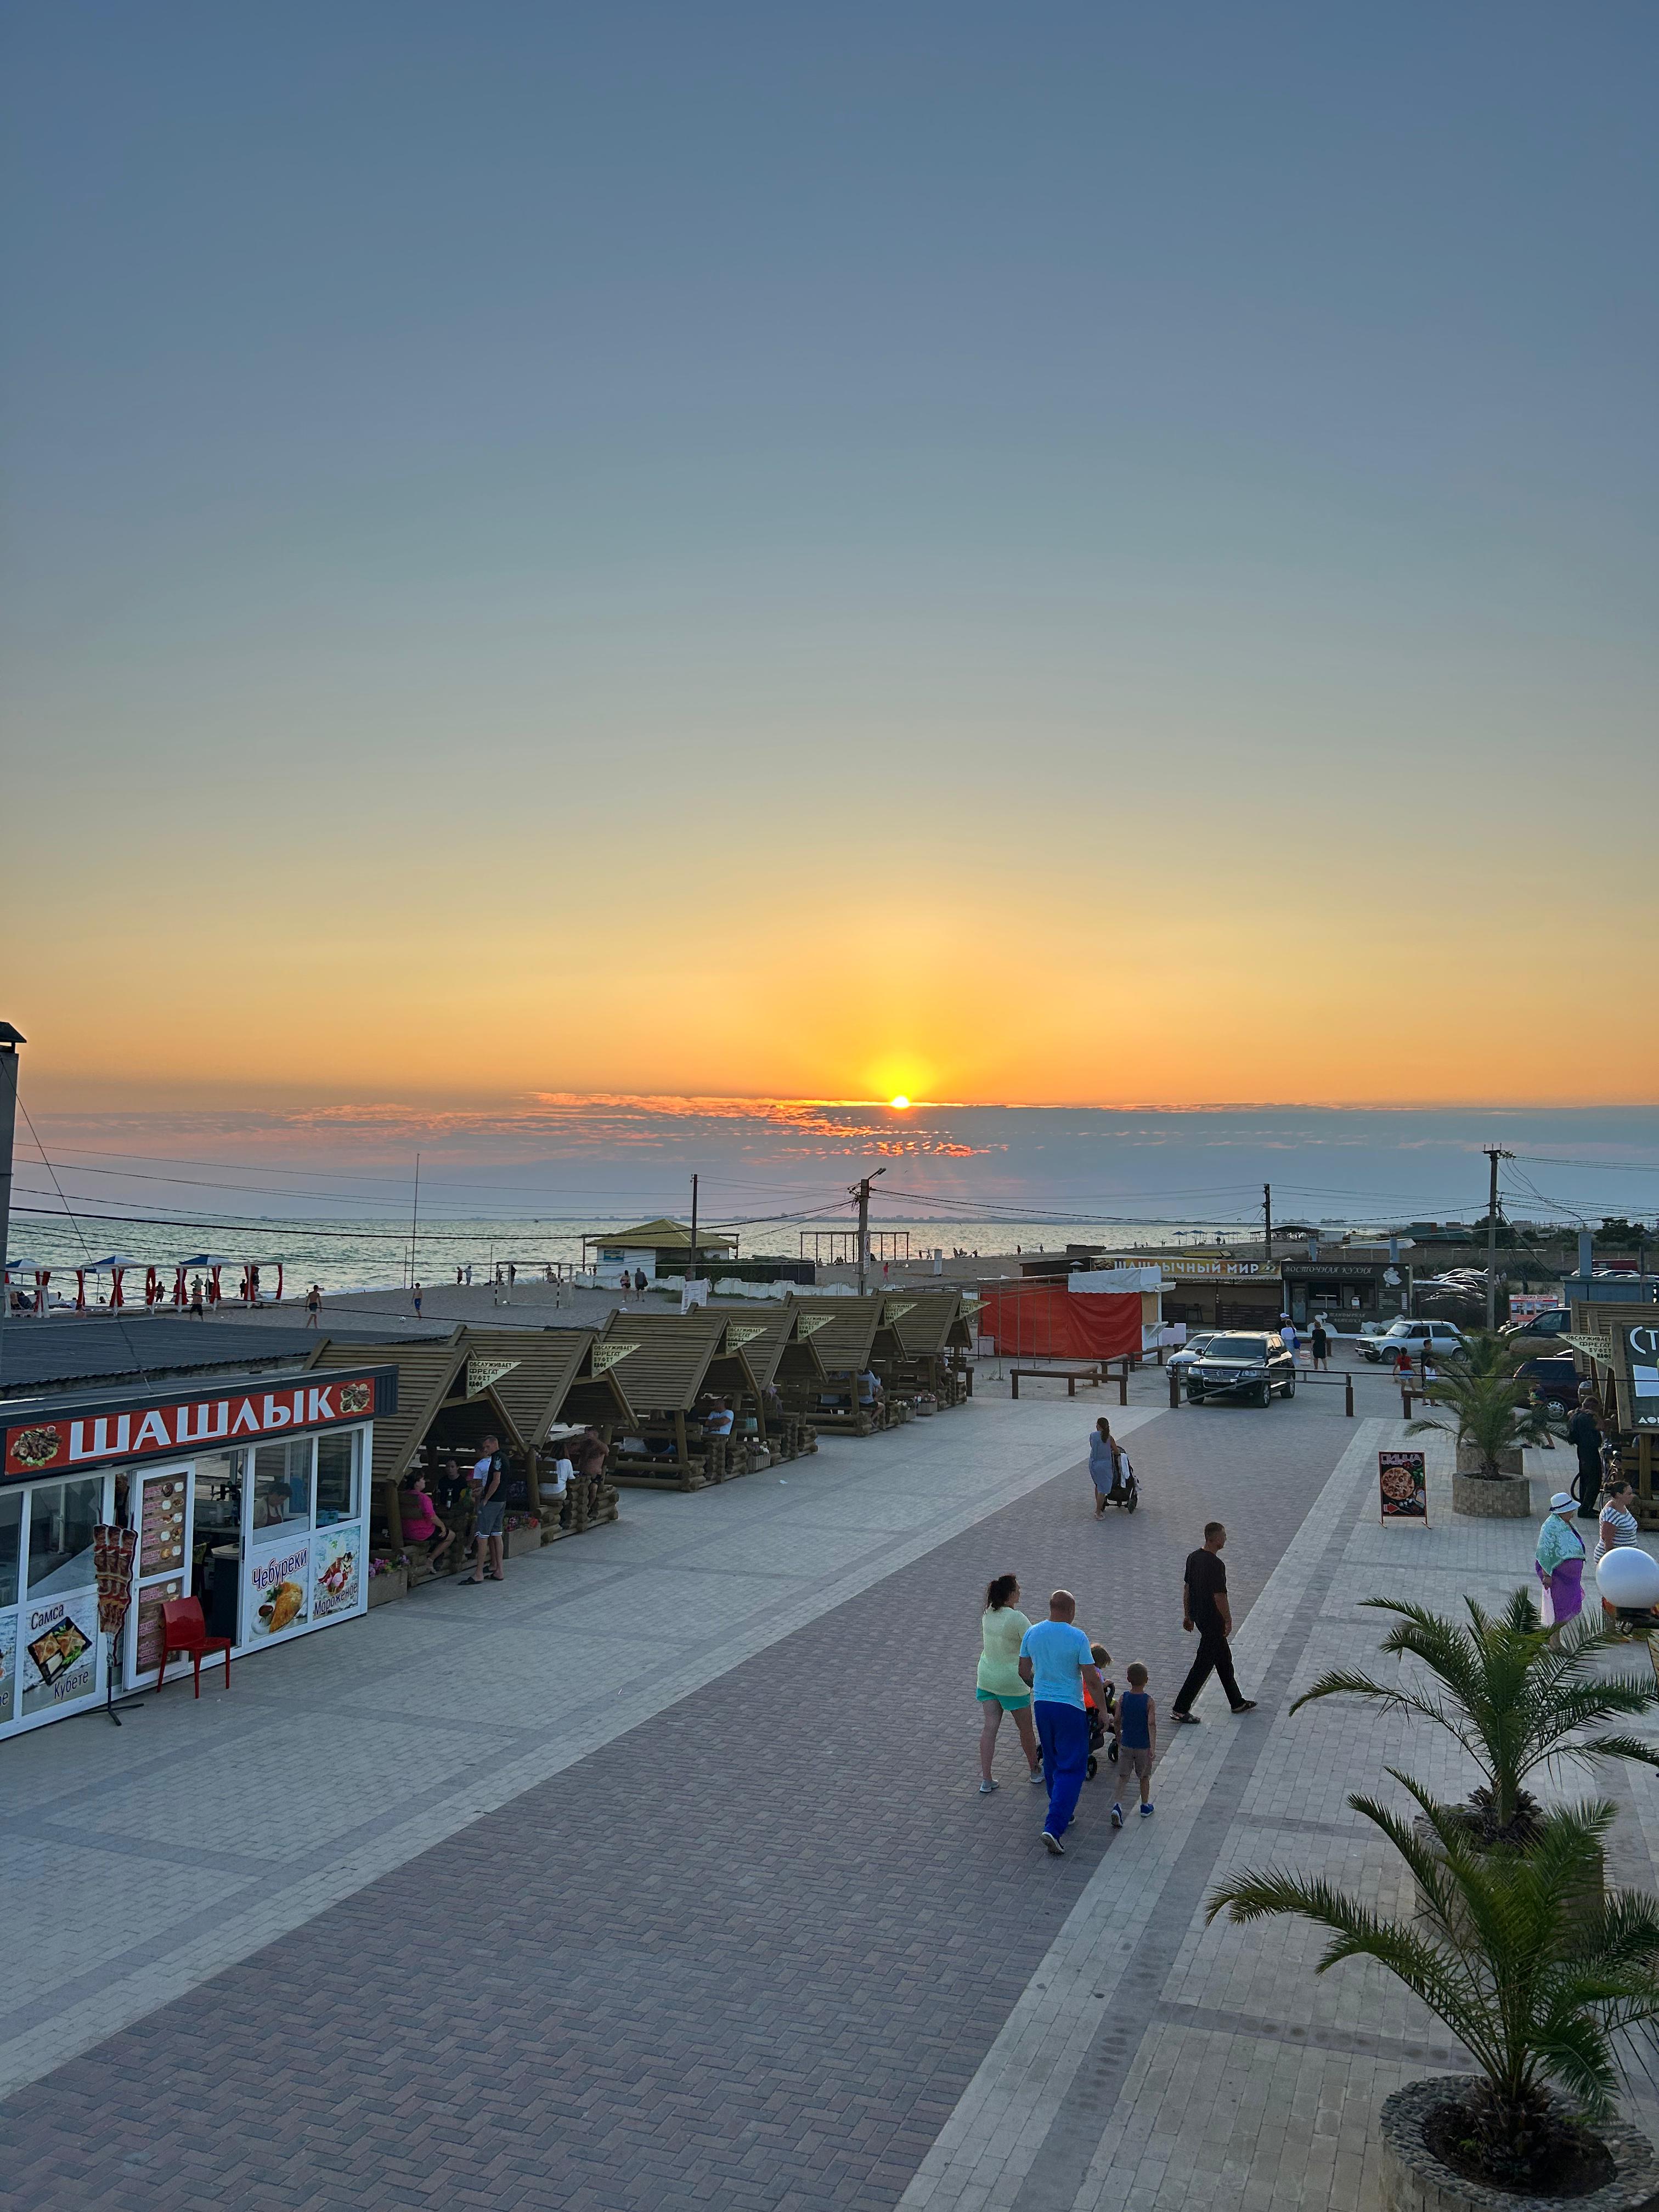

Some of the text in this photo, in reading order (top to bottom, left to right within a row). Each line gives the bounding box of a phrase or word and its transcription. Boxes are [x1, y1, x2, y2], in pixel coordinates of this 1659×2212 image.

[1227, 1263, 1259, 1273] МИР
[70, 1386, 335, 1460] ШАШЛЫК
[253, 1548, 307, 1590] Чебуреки
[314, 1583, 357, 1616] Мороженое
[31, 1604, 64, 1630] Самса
[55, 1671, 88, 1701] Кубете
